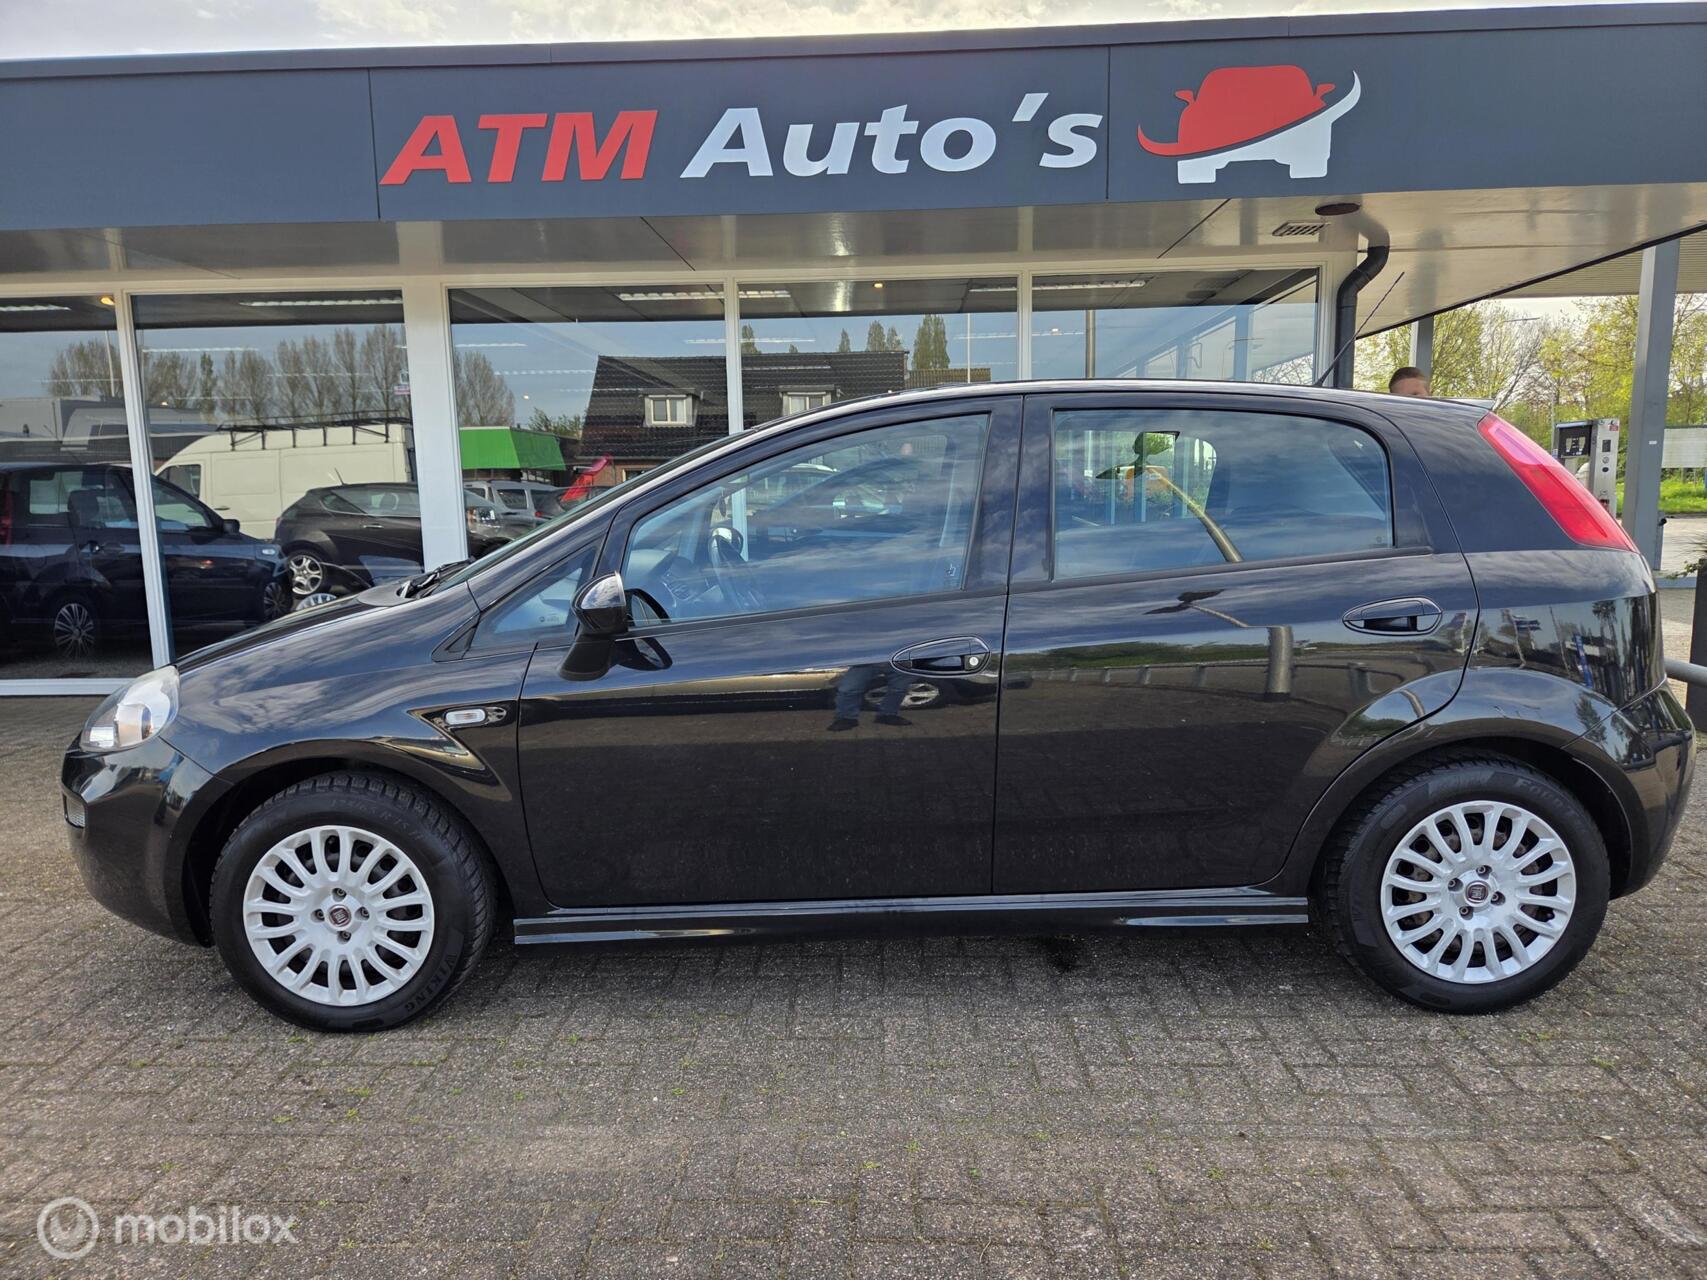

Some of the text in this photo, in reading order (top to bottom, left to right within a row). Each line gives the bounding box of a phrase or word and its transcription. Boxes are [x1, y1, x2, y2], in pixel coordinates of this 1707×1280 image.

[379, 92, 1104, 186] ATM Auto's
[404, 953, 459, 1014] VIKING
